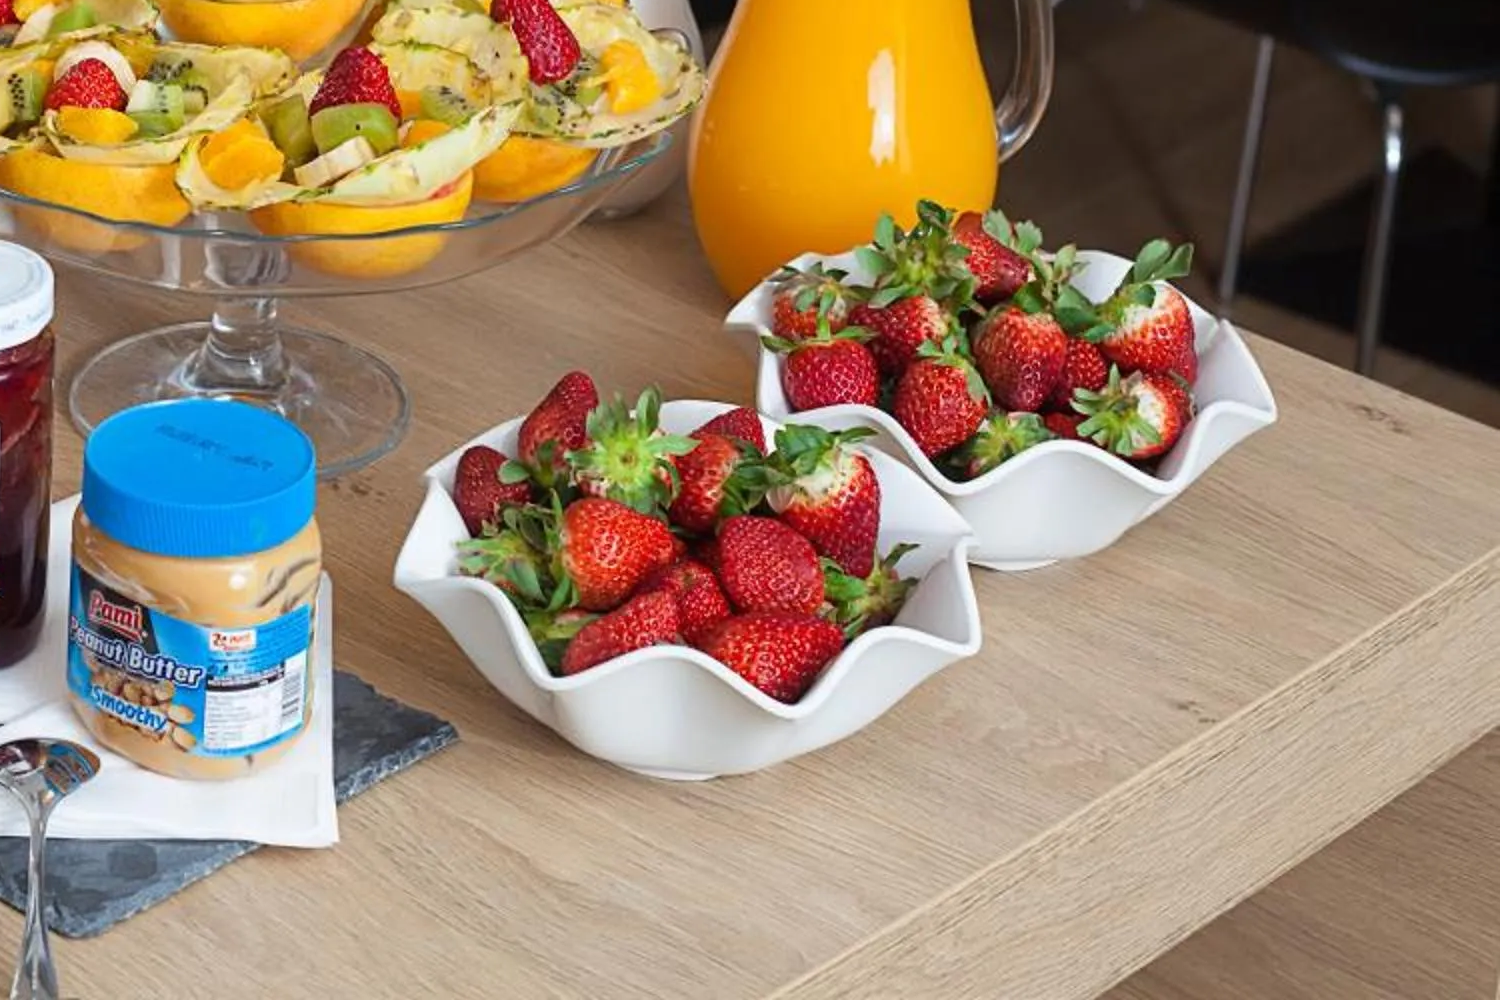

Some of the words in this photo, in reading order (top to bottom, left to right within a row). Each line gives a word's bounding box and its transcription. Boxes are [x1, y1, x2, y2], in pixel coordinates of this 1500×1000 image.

[88, 591, 142, 631] Pami
[128, 645, 204, 687] Butter
[91, 687, 168, 730] Smoothy
